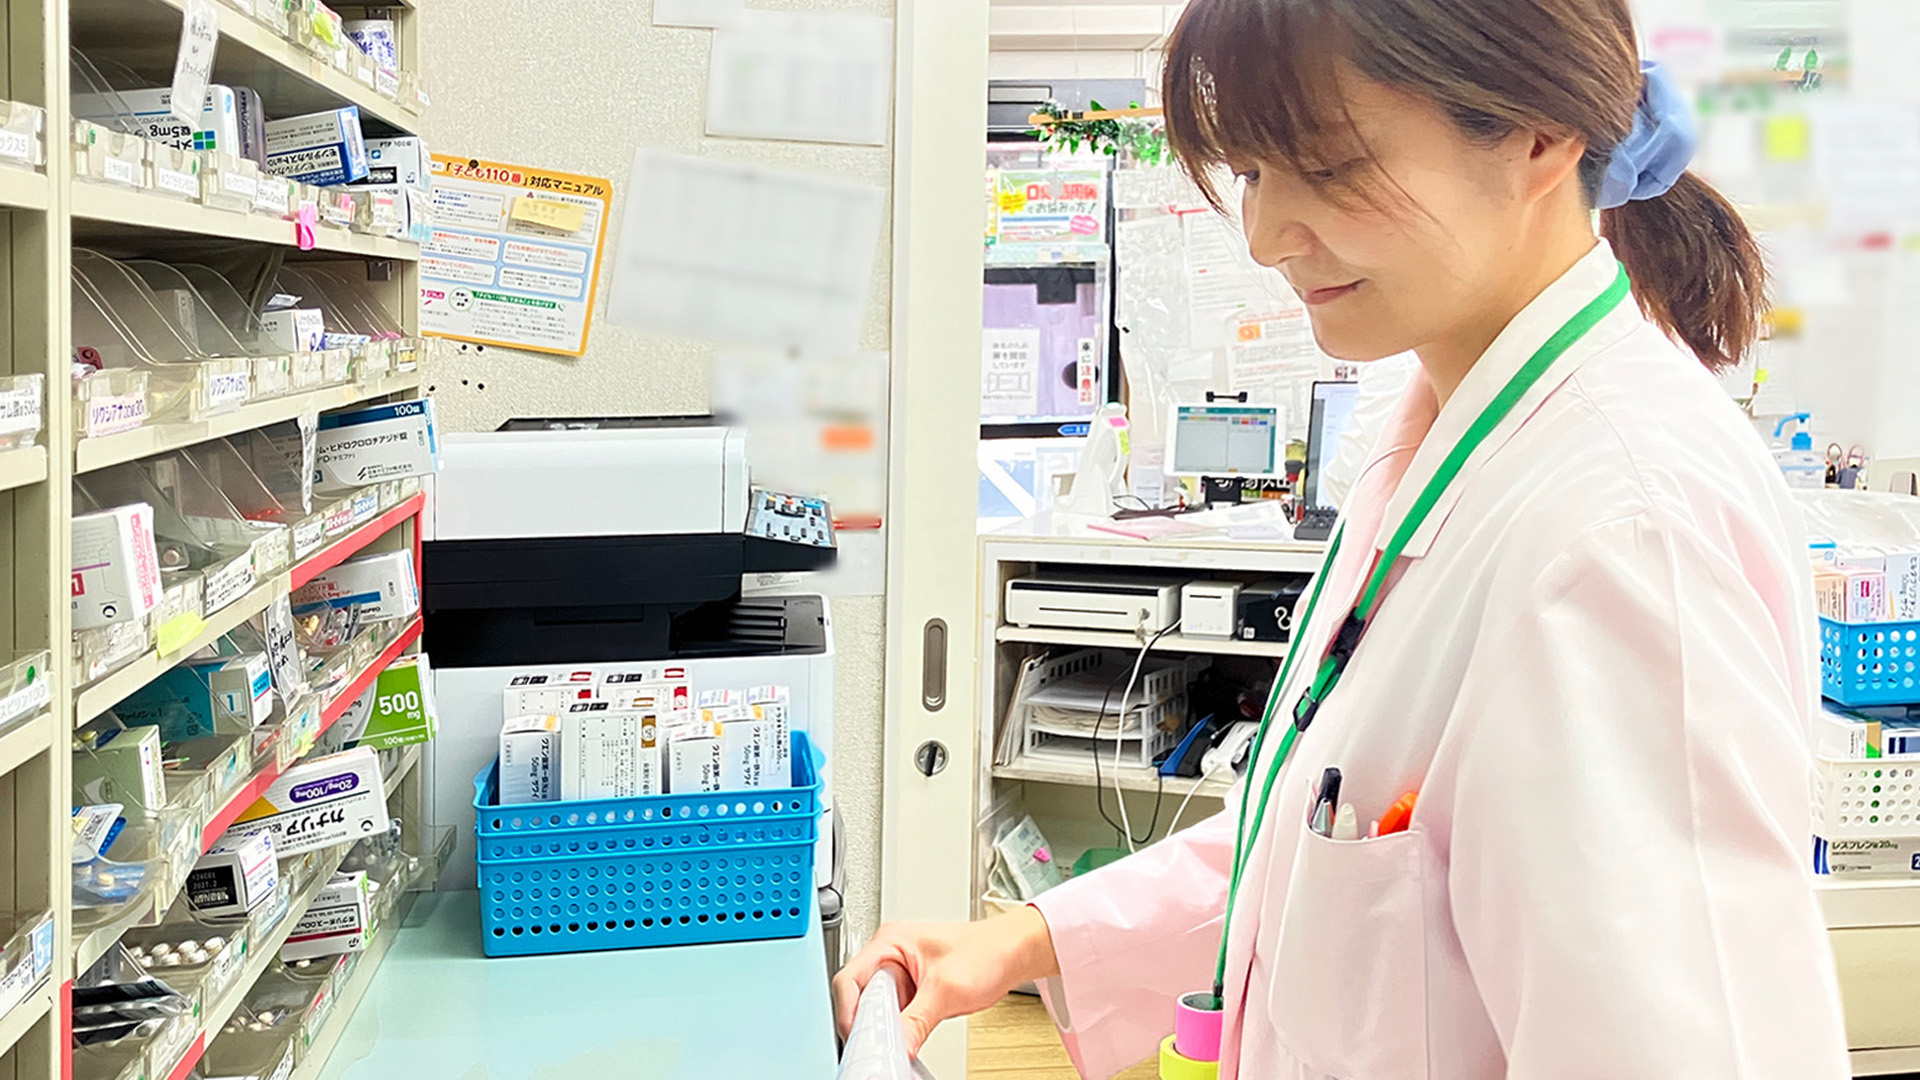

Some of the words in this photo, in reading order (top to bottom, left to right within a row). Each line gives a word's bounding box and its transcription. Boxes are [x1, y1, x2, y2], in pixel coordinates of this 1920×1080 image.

[379, 691, 419, 715] 500
[406, 710, 421, 720] mg
[286, 808, 345, 836] カナリア
